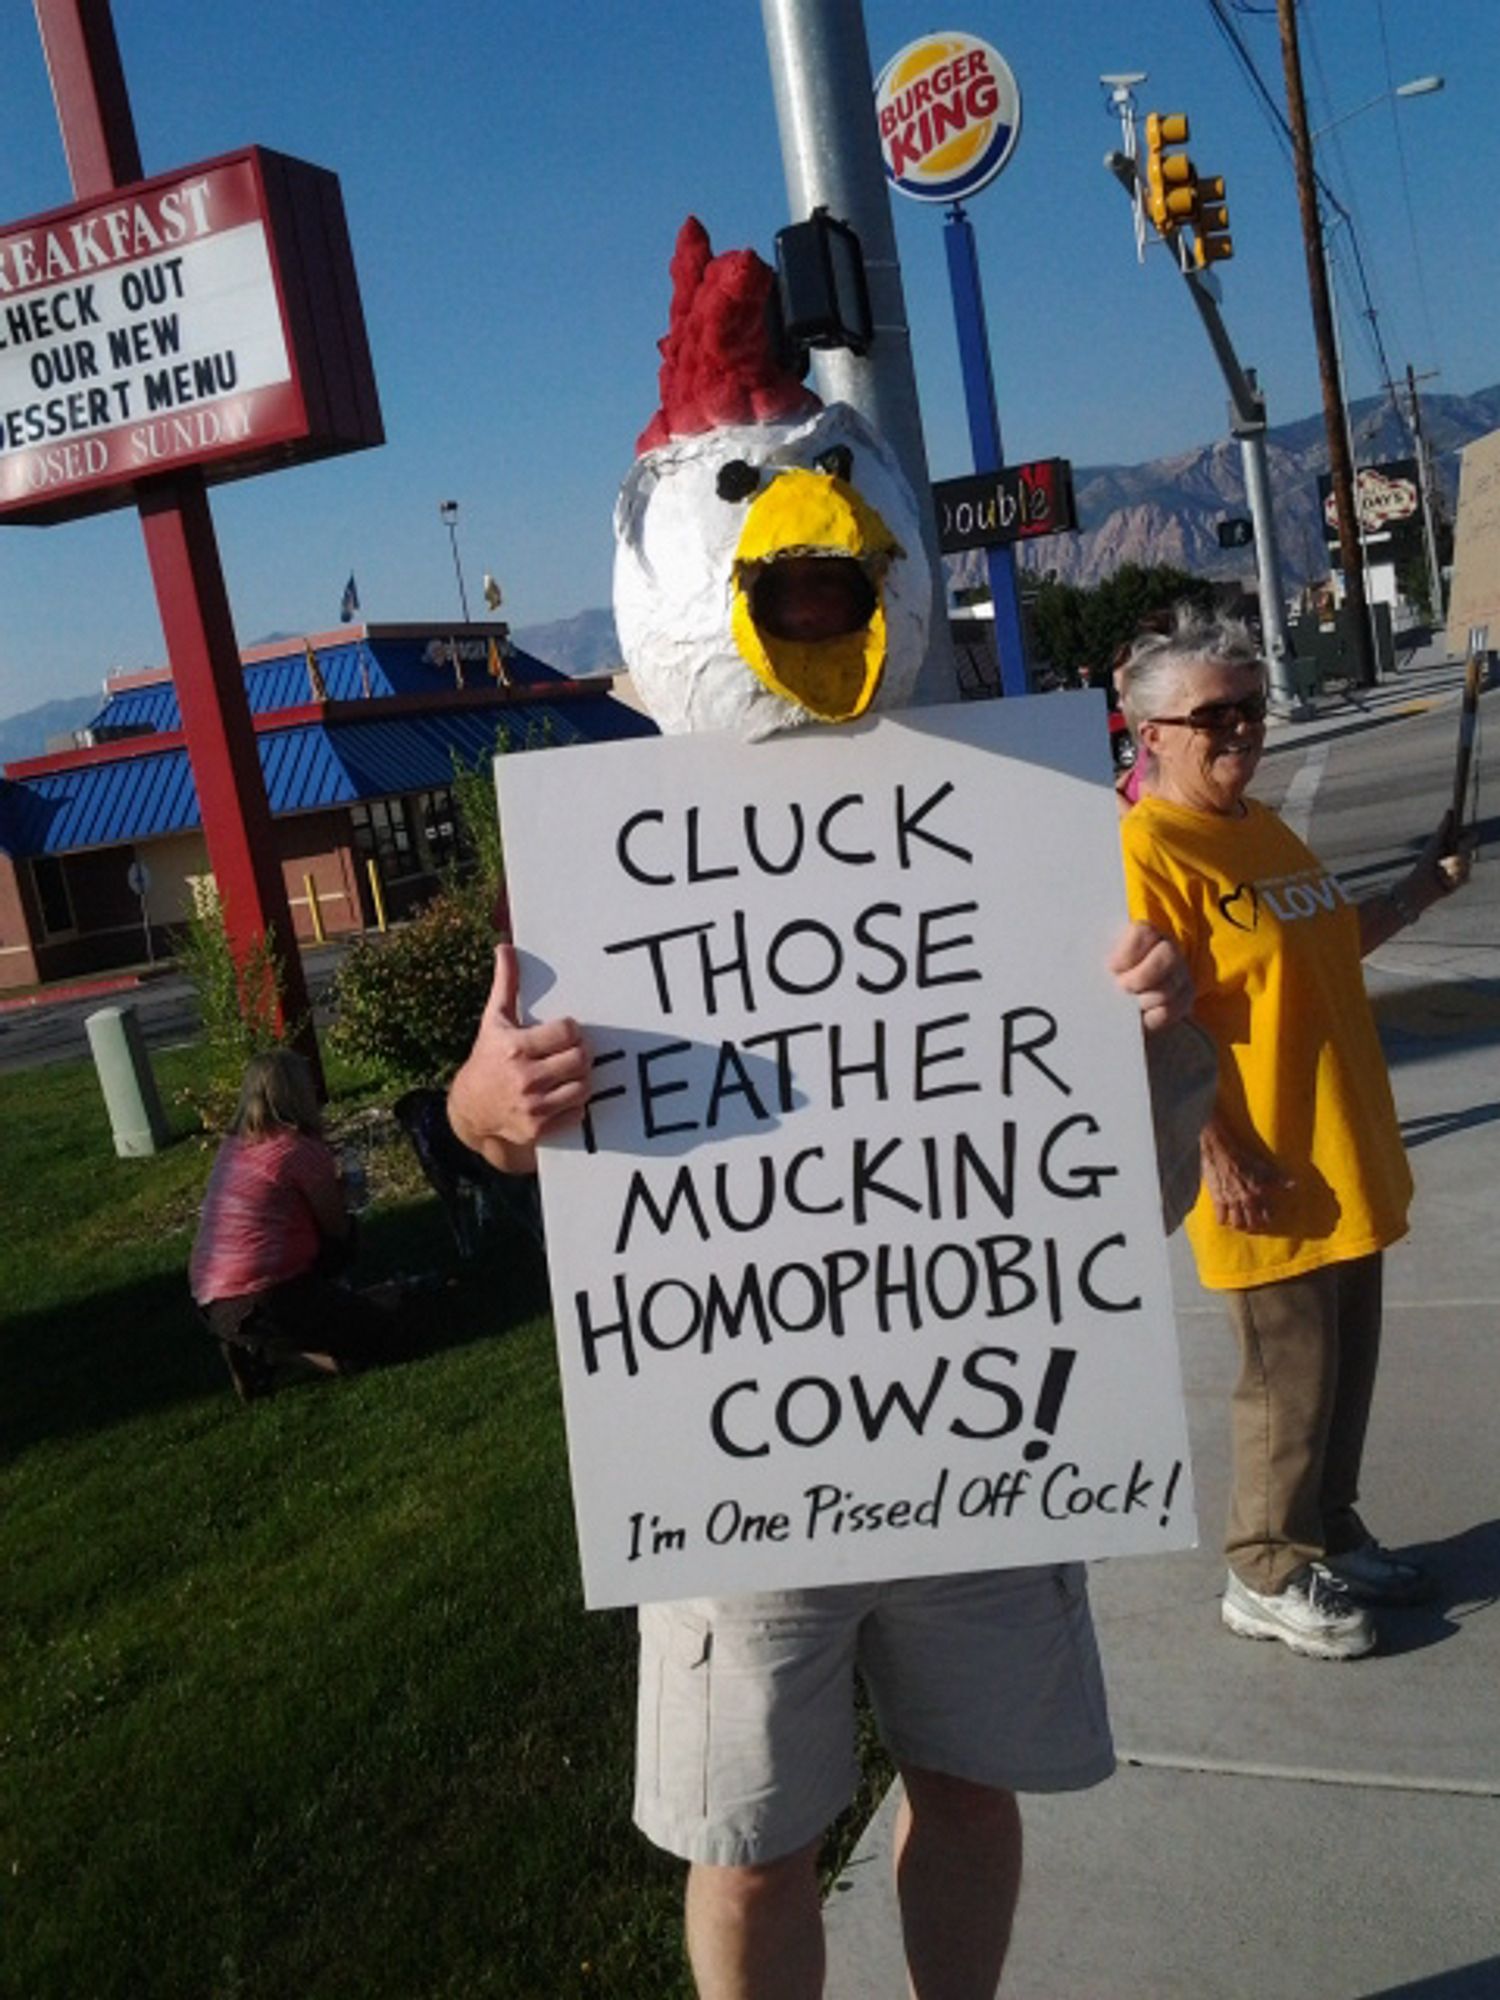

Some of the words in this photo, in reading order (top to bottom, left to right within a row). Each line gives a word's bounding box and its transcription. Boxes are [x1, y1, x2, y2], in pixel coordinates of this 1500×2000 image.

[880, 49, 988, 138] BURGER
[890, 75, 998, 177] KING
[0, 284, 101, 350] HECK
[121, 258, 184, 311] OUT
[31, 340, 98, 389] OUR
[109, 313, 180, 369] NEW
[0, 381, 130, 450] ESSERT
[144, 351, 238, 412] MENU
[131, 399, 252, 463] SUNDAY
[617, 781, 973, 886] CLUCK
[603, 901, 982, 1015] THOSE
[583, 1006, 1072, 1154] FEATHER
[615, 1113, 1118, 1254] MUCKING
[575, 1233, 1142, 1377] HOMOPHOBIC
[711, 1346, 1077, 1462] COWS!
[628, 1512, 686, 1561] I'm
[706, 1500, 789, 1544] One
[804, 1468, 949, 1539] Pissed
[958, 1469, 1030, 1517] Off
